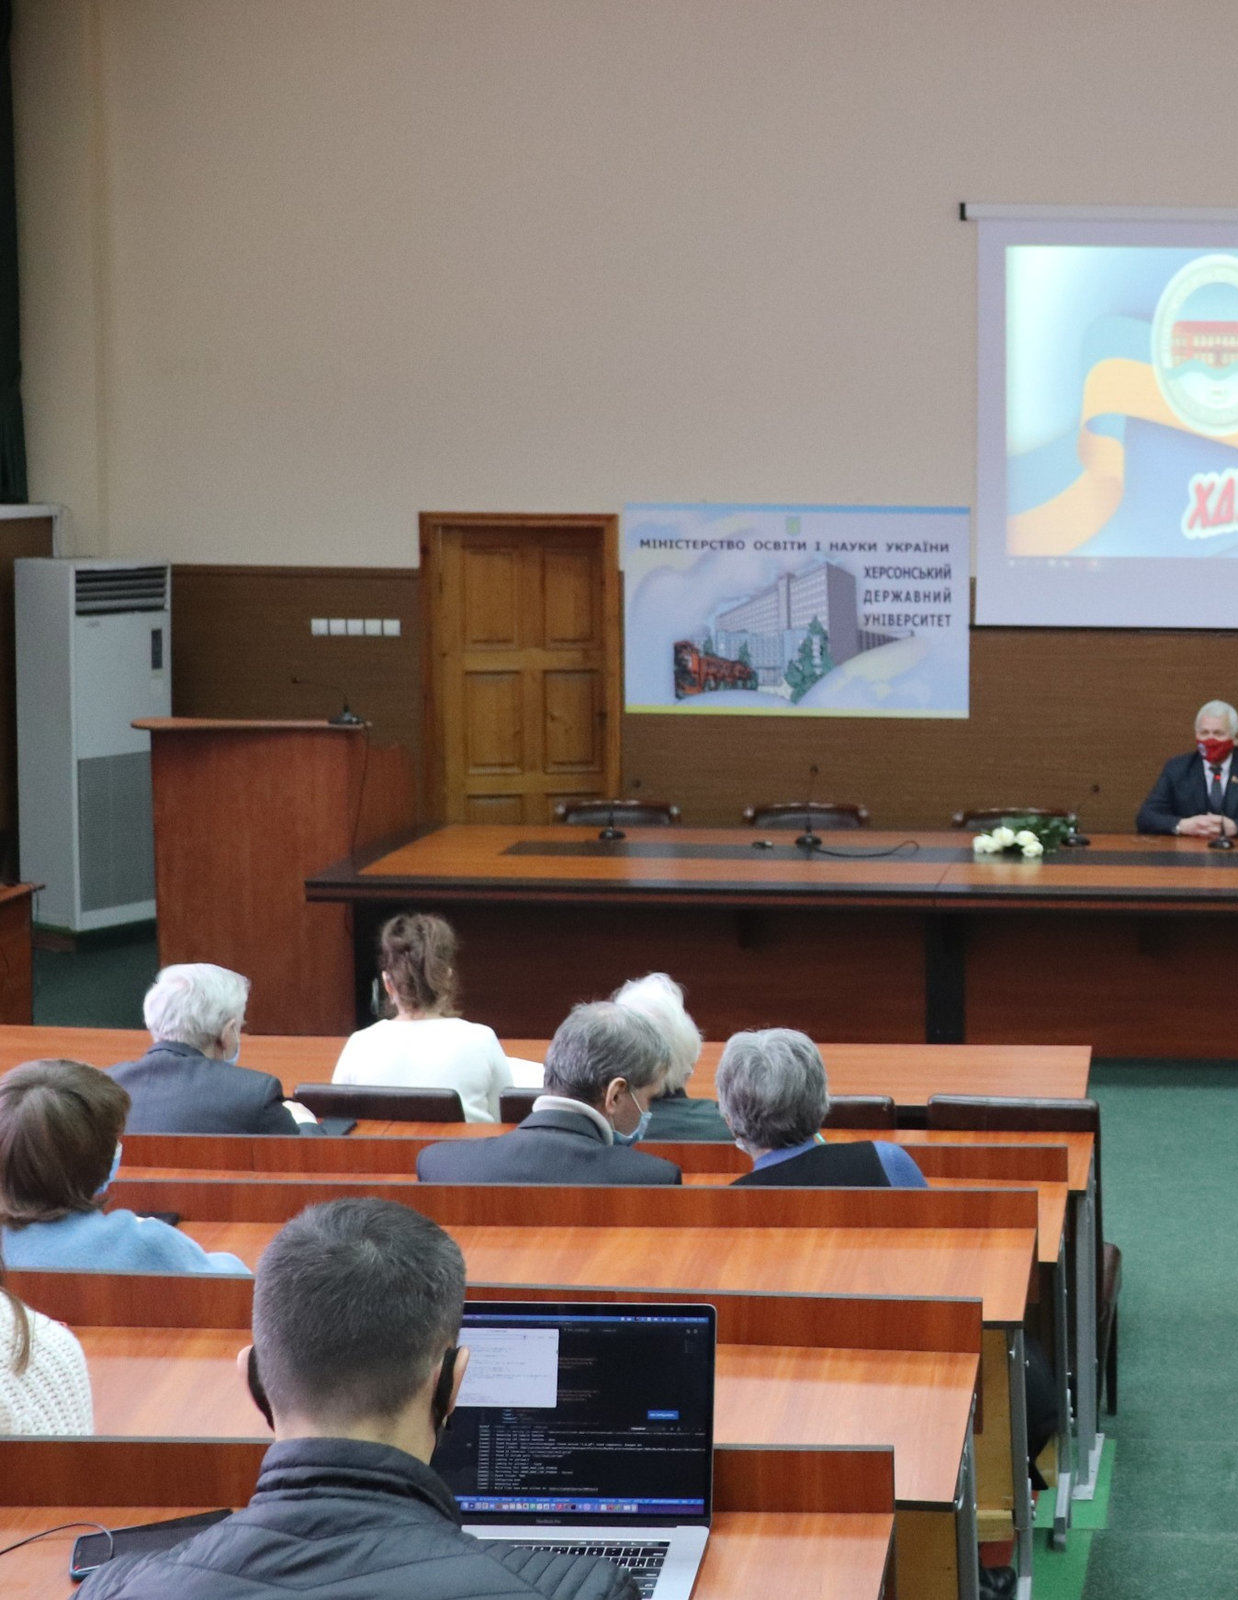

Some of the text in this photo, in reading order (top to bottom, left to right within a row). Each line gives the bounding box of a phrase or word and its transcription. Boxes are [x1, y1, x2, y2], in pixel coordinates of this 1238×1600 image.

[639, 538, 950, 553] МІНІСТЕРСТВО ОСВІТИ І НАУКИ УКРАЇНИ
[863, 563, 952, 580] ХЕРСОНСЬКИЙ
[863, 586, 952, 605] ДЕРЖАВНИЙ
[863, 613, 952, 628] УНІВЕРСИТЕТ
